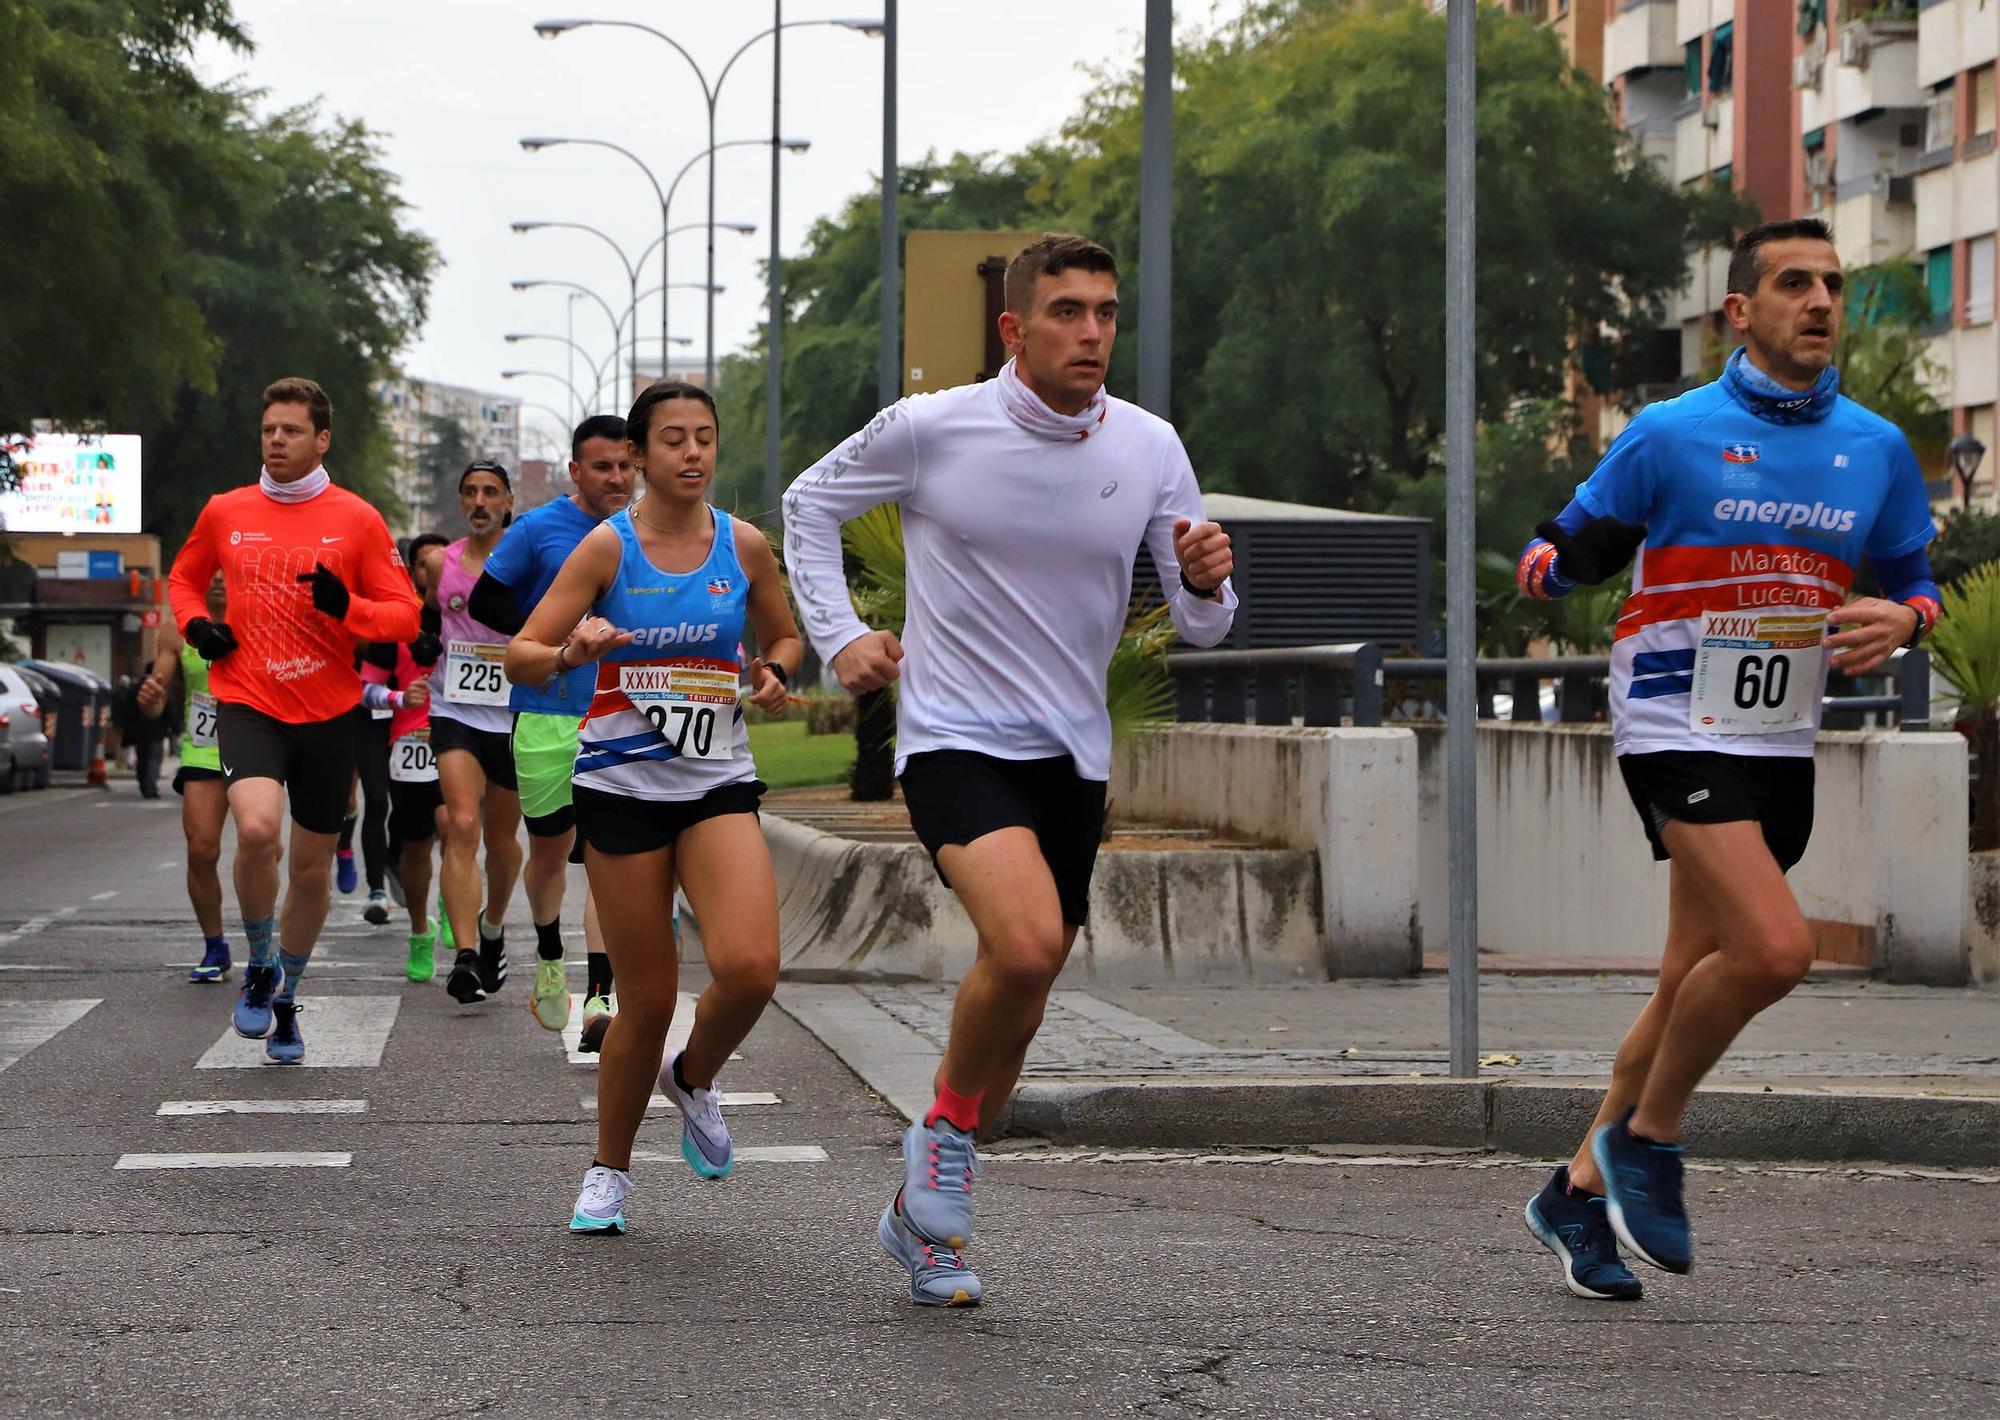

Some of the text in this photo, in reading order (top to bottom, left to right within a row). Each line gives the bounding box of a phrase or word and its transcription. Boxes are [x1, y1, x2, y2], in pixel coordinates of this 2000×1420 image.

[1713, 498, 1857, 532] enerplus
[1730, 548, 1829, 579] Maratón
[1737, 585, 1820, 607] Lucena
[1706, 617, 1758, 637] XXXIX
[459, 663, 502, 693] 225
[625, 671, 670, 690] XXXIX
[1734, 654, 1790, 709] 60
[402, 745, 437, 770] 204
